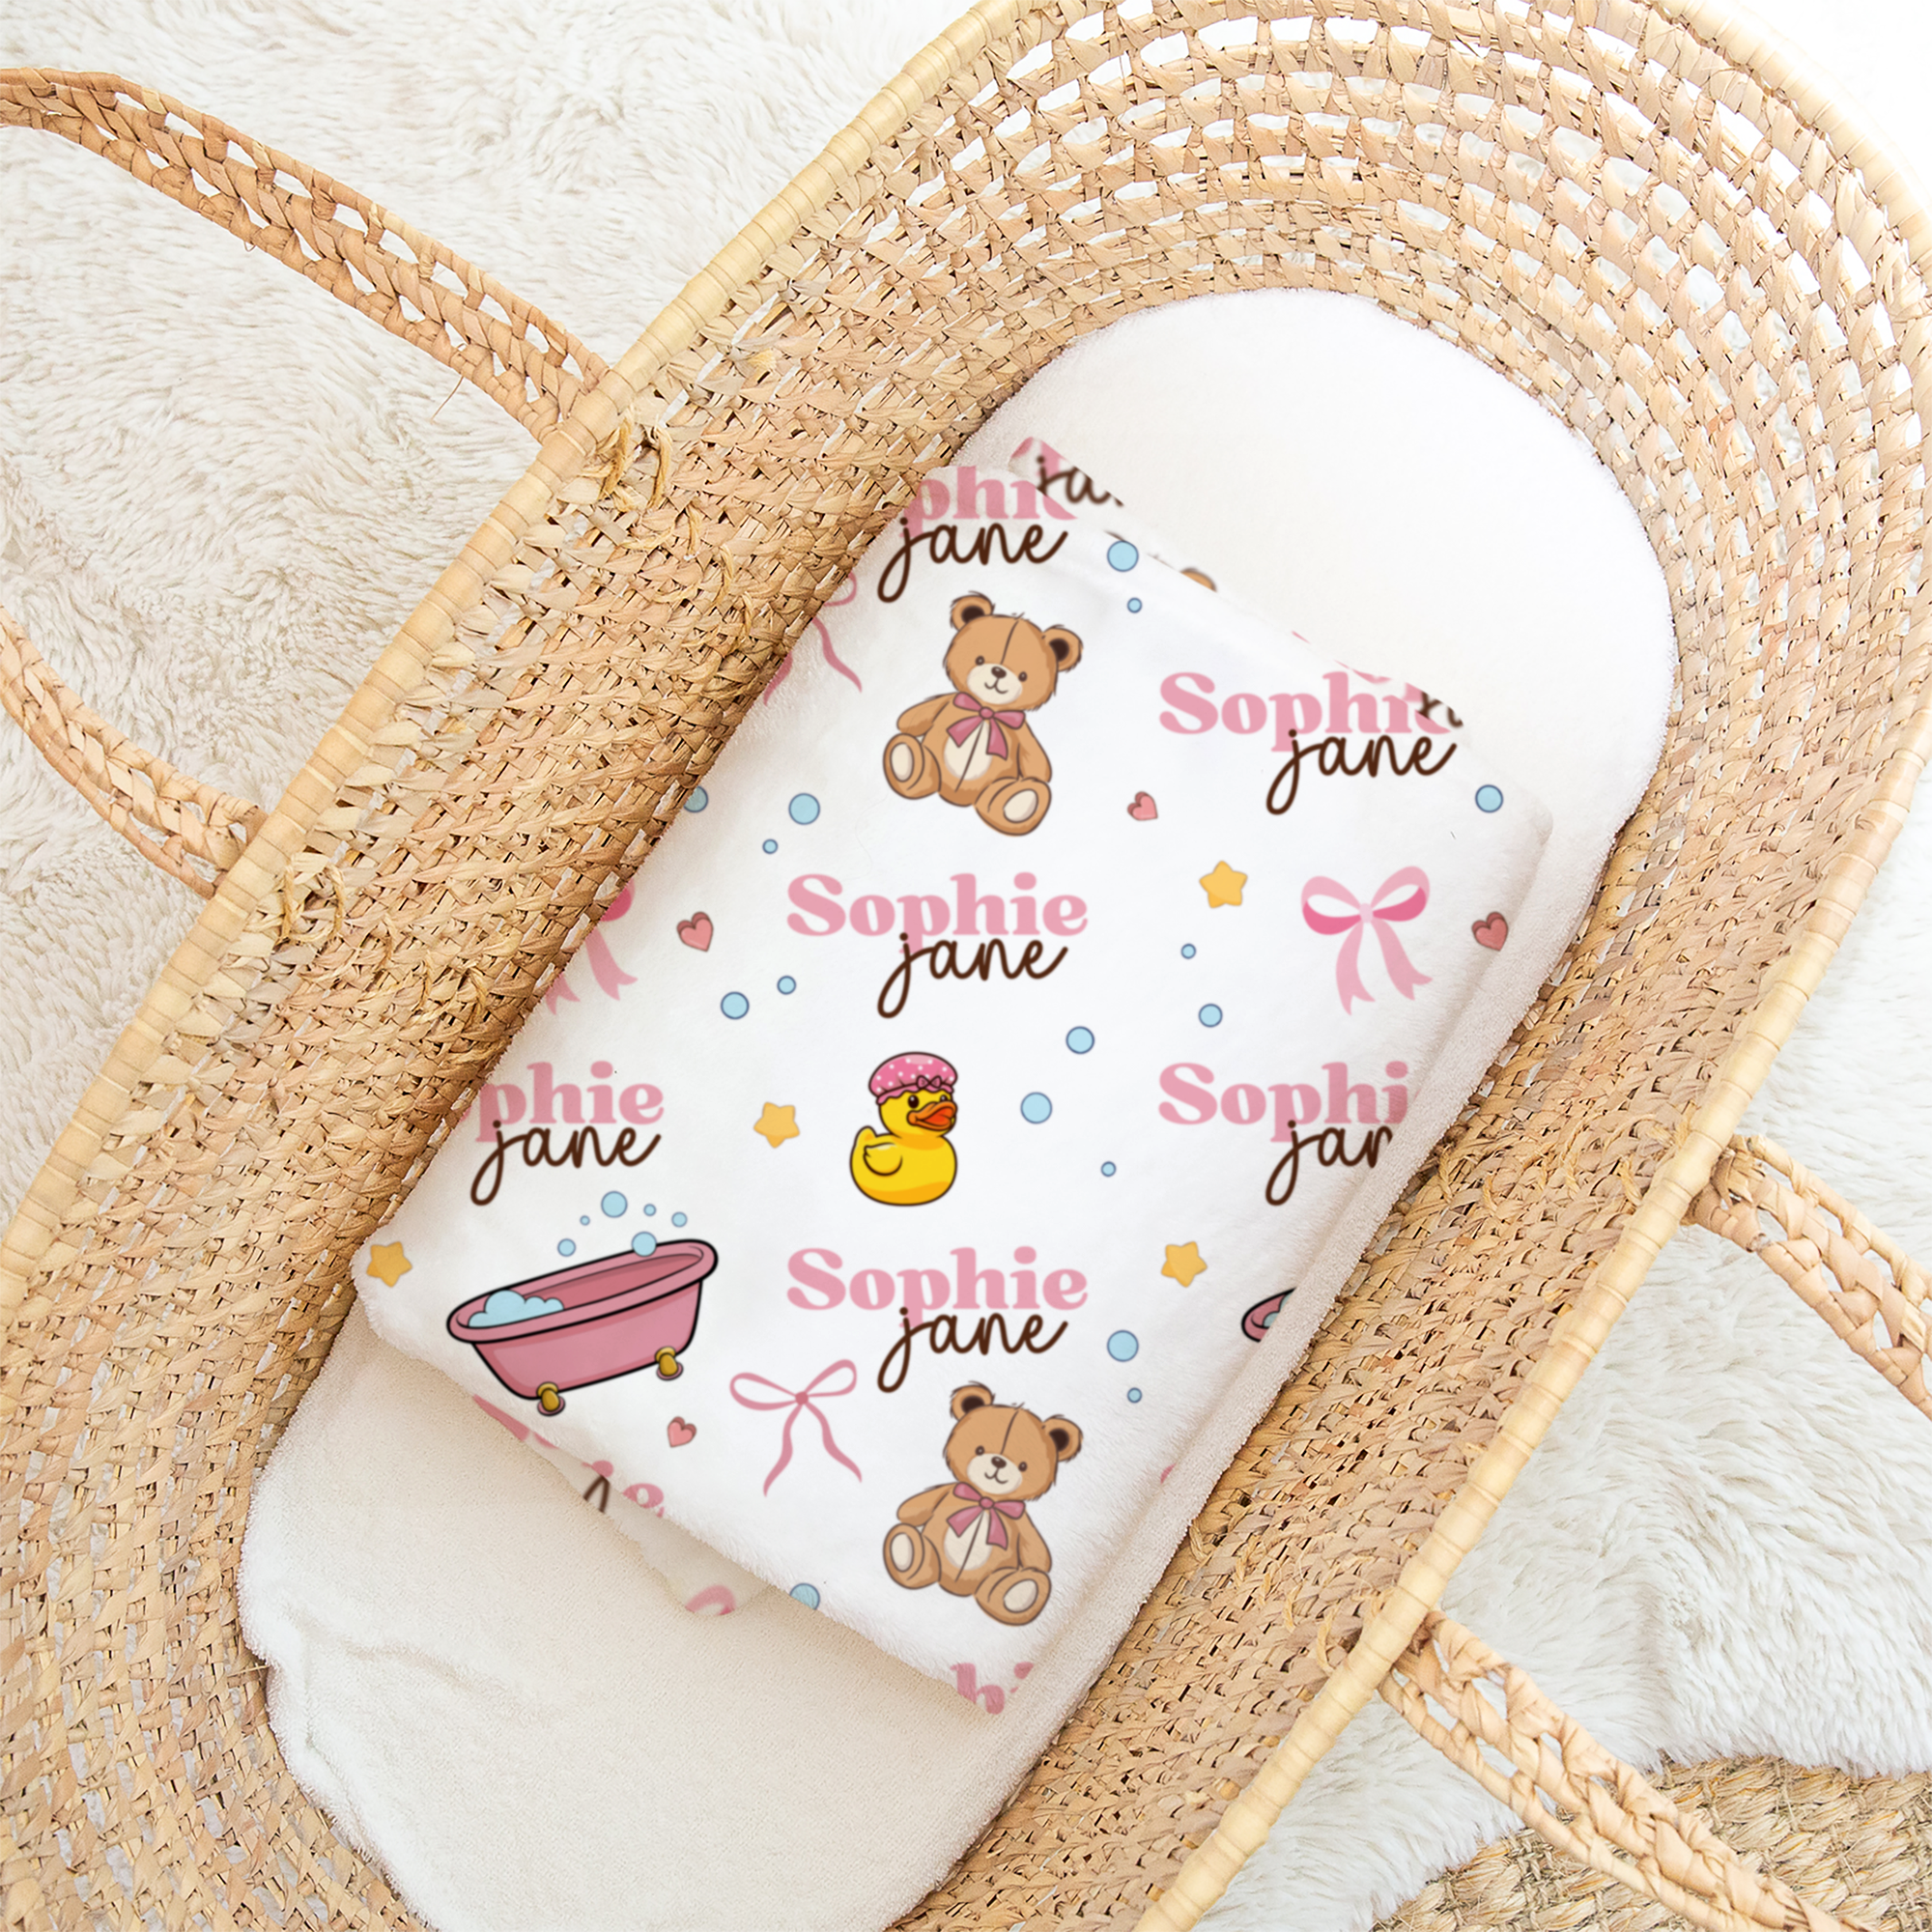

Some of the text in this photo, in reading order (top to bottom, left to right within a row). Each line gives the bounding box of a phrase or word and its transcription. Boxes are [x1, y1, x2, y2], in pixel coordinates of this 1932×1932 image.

[877, 516, 1069, 603] jane
[1265, 728, 1458, 815] jane
[786, 871, 1089, 954] Sophie
[877, 932, 1069, 1019] jane
[475, 1061, 665, 1143] phie
[1158, 1061, 1410, 1143] Sophi
[469, 1120, 662, 1207] jane
[1264, 1120, 1393, 1207] jan
[786, 1245, 1089, 1328] Sophie
[877, 1306, 1069, 1393] jane
